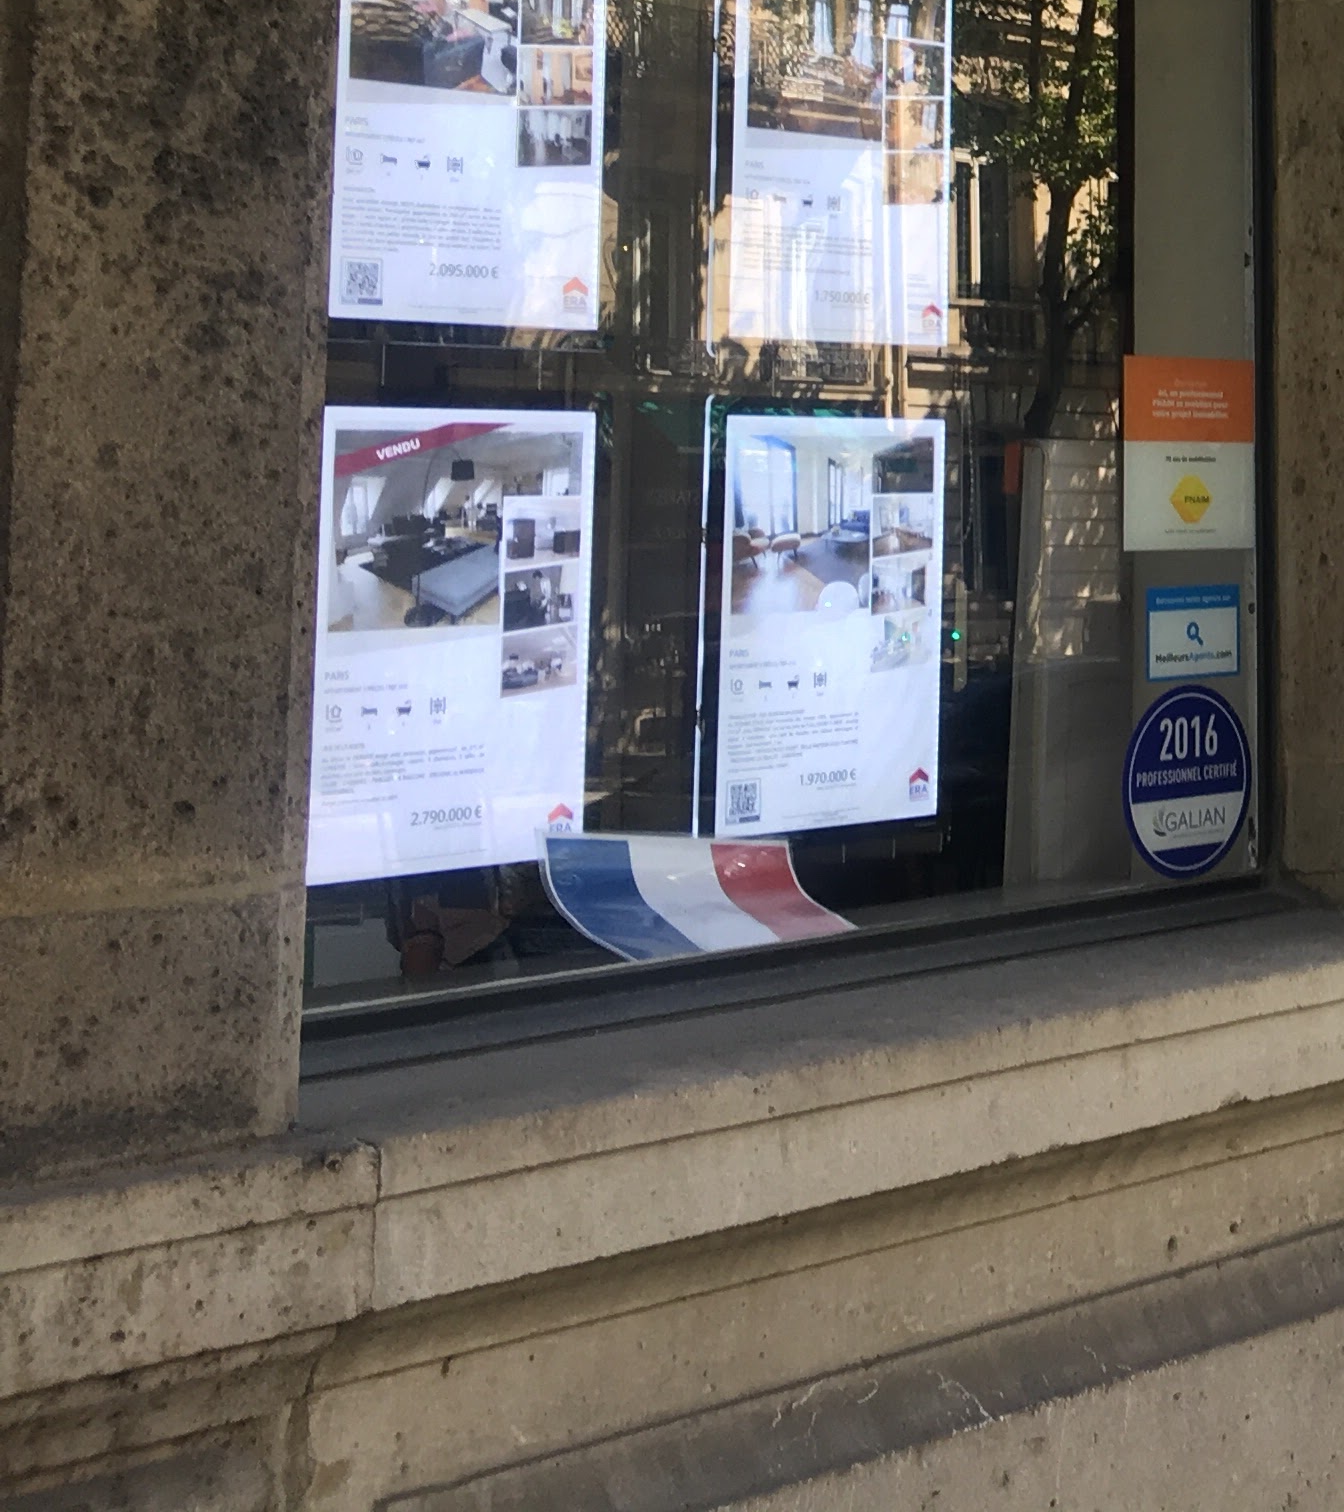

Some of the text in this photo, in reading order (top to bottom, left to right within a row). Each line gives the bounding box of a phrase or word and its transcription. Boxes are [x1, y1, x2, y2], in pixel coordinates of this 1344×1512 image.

[429, 262, 499, 279] 2.095.000 €
[375, 437, 421, 461] VENDU
[324, 670, 350, 681] PARIS
[1159, 713, 1219, 762] 2016
[799, 768, 857, 787] 1.970.000 €
[1135, 759, 1238, 788] PROFESSIONNEL CERTIFIÉ
[909, 783, 929, 796] ERA
[410, 806, 472, 827] 2.790.000
[474, 805, 483, 819] €
[1165, 806, 1227, 833] GALIAN
